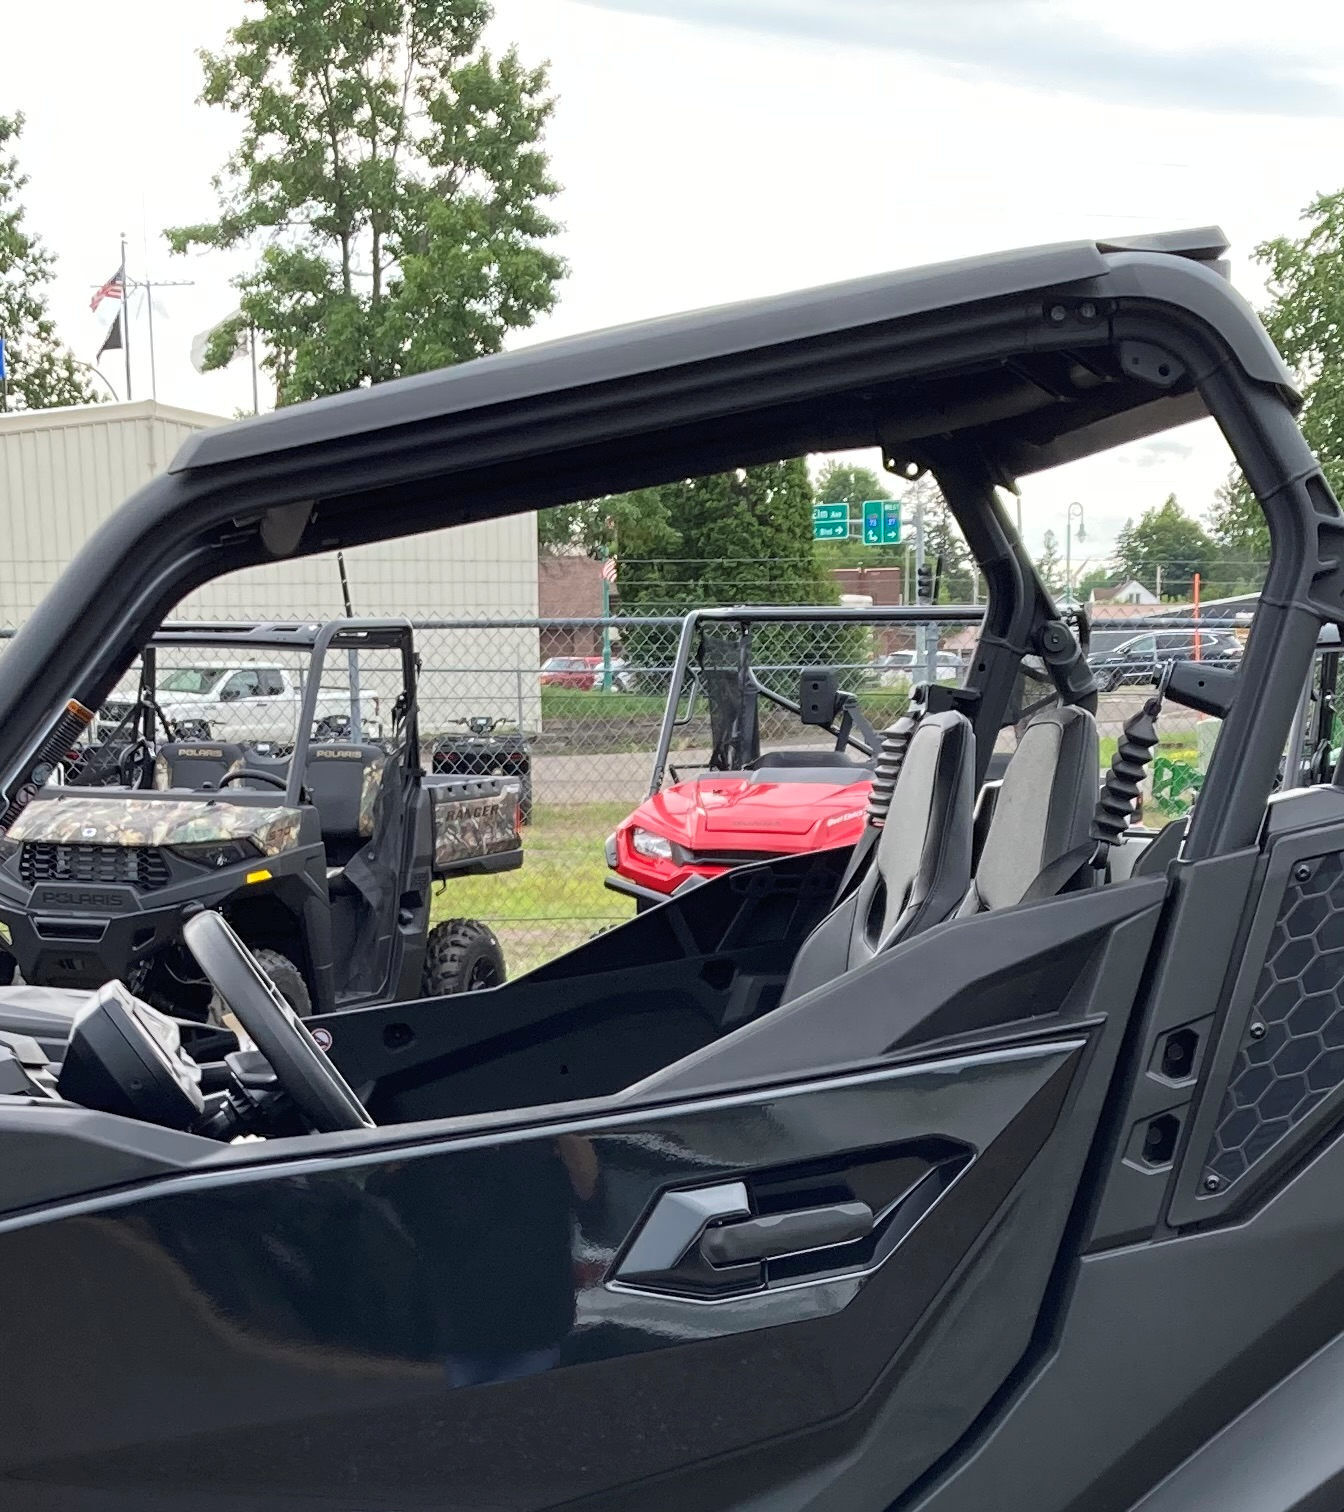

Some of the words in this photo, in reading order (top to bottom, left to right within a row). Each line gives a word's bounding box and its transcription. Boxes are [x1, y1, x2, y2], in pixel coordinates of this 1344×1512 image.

[178, 748, 223, 758] POLARIS
[316, 749, 363, 759] POLARIS
[446, 804, 500, 822] RANGER
[42, 891, 124, 906] POLARIS
